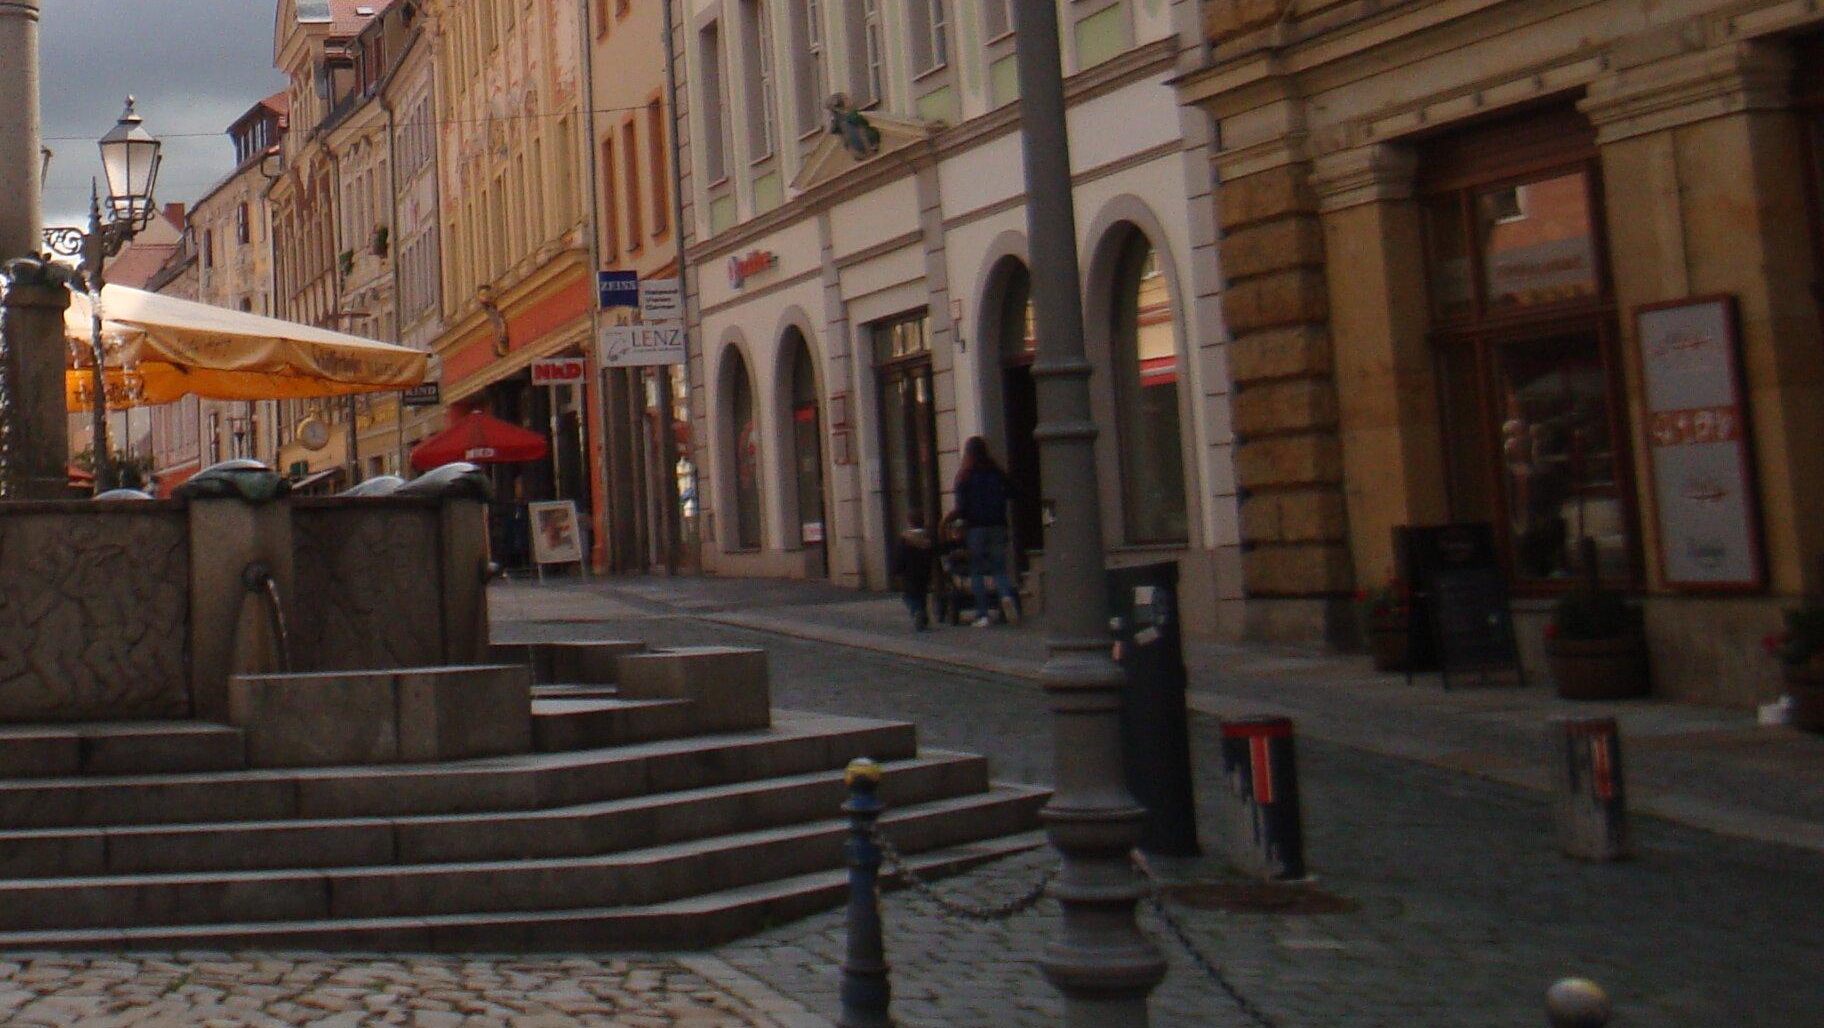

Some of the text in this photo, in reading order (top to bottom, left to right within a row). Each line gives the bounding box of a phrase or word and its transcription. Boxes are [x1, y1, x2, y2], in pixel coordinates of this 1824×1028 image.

[600, 280, 637, 292] ZEISS
[631, 329, 681, 348] LENZ
[534, 362, 582, 380] NKD
